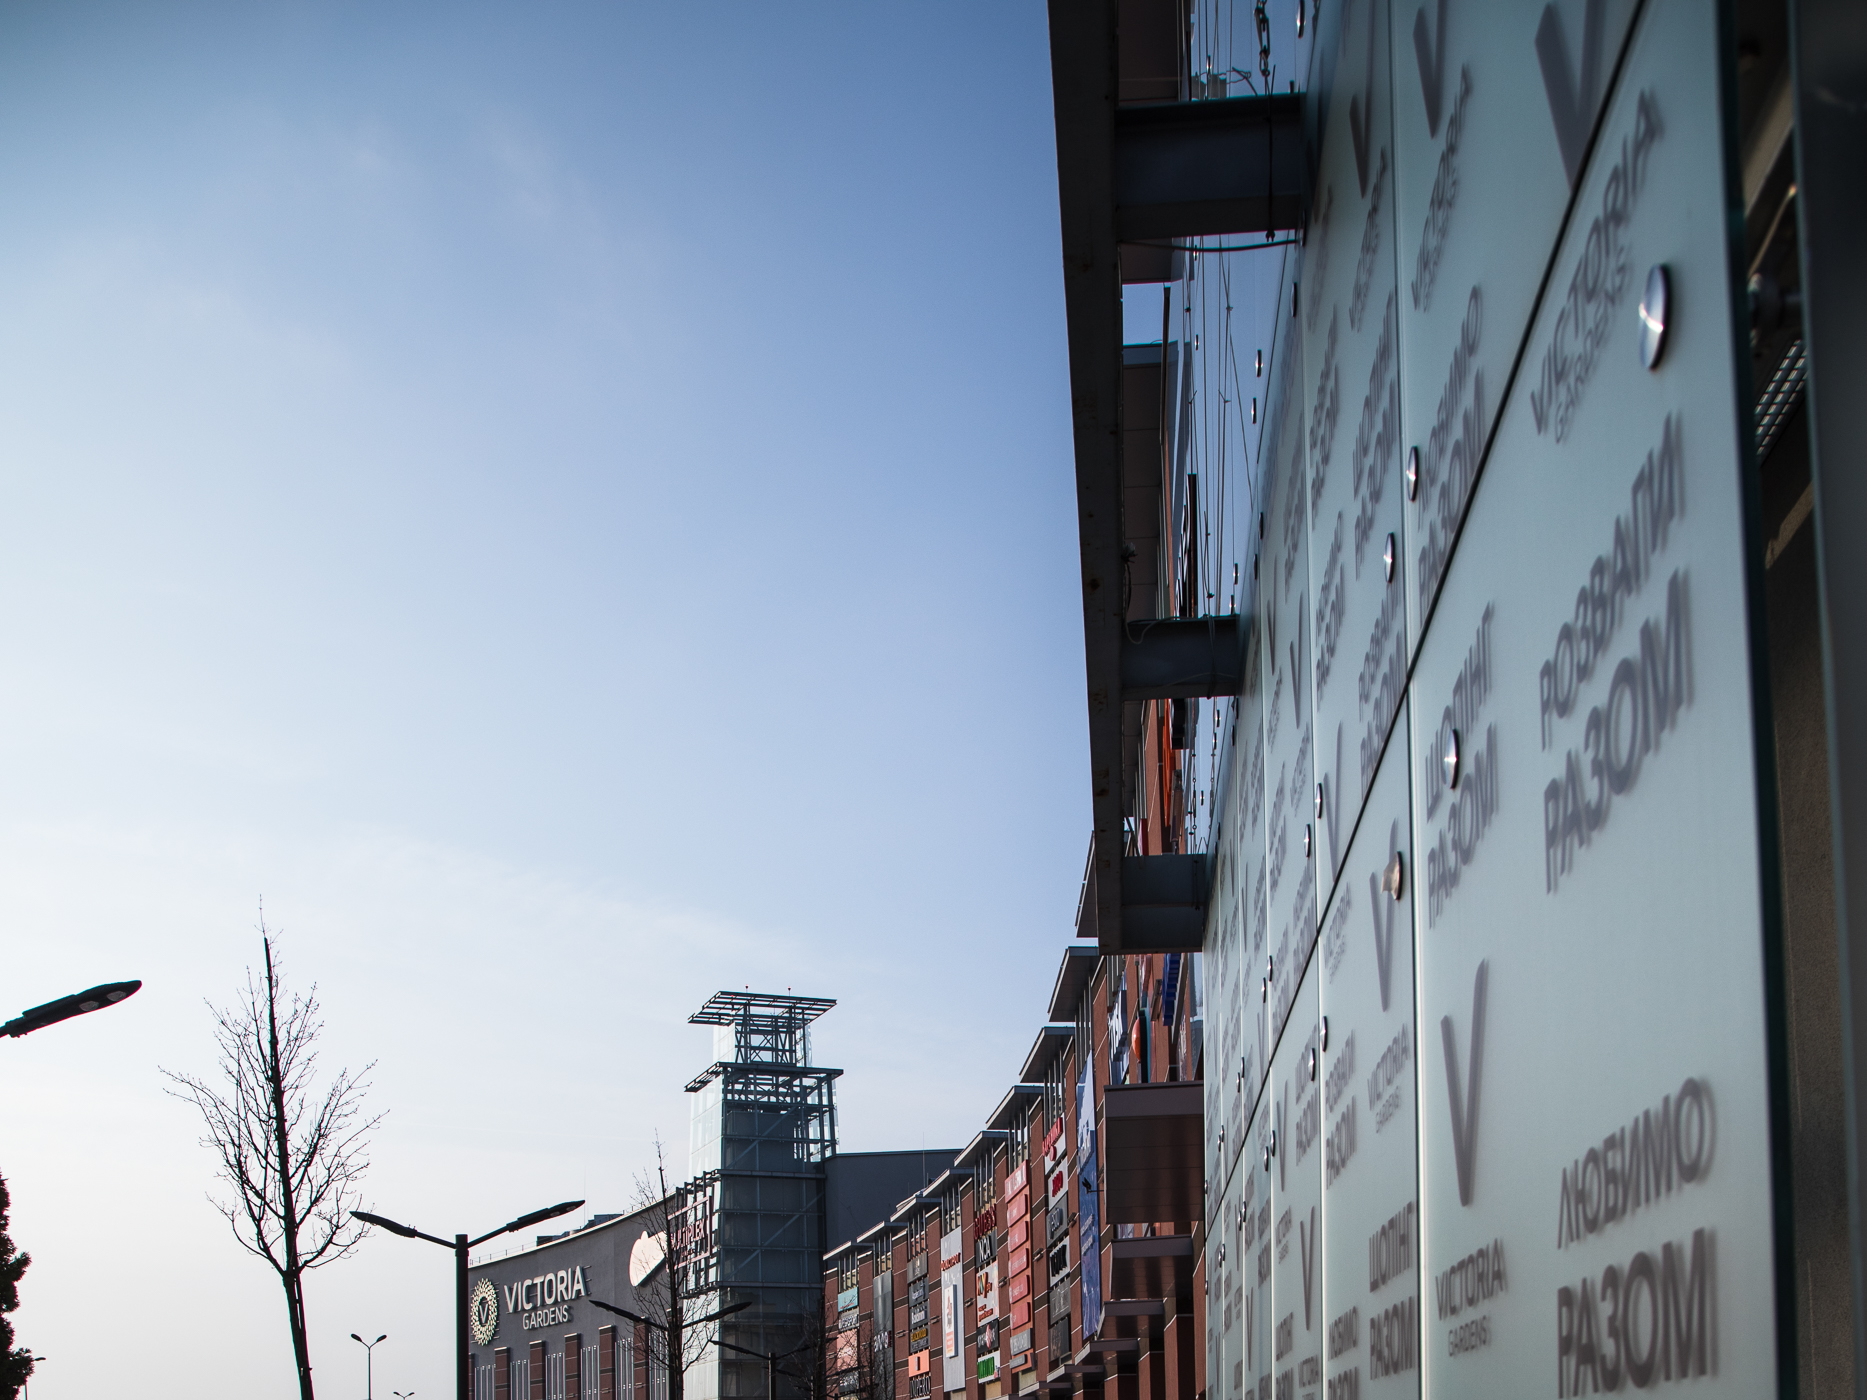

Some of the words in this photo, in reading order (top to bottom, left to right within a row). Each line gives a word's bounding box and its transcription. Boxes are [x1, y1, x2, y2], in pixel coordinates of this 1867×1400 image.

[1411, 63, 1473, 311] VICTORIA
[1531, 88, 1662, 437] VICTORIA
[1555, 244, 1632, 443] GARDENS
[1355, 378, 1396, 581] РАЗОМ
[1323, 722, 1342, 883] V
[1544, 564, 1694, 896] РАЗОМ
[1427, 723, 1498, 930] РАЗОМ
[1440, 957, 1490, 1206] V
[1558, 1077, 1715, 1249] ЛЮБИМО
[504, 1265, 586, 1314] VICTORIA
[974, 1203, 997, 1240] GUESS
[1300, 1205, 1315, 1331] V
[1369, 1201, 1414, 1293] ШОПІНГ
[1435, 1237, 1507, 1320] VICTORIA
[523, 1305, 569, 1331] GARDENS
[1370, 1296, 1416, 1380] РАЗОМ
[1448, 1314, 1490, 1356] GARDENS
[1557, 1227, 1717, 1400] РАЗОМ
